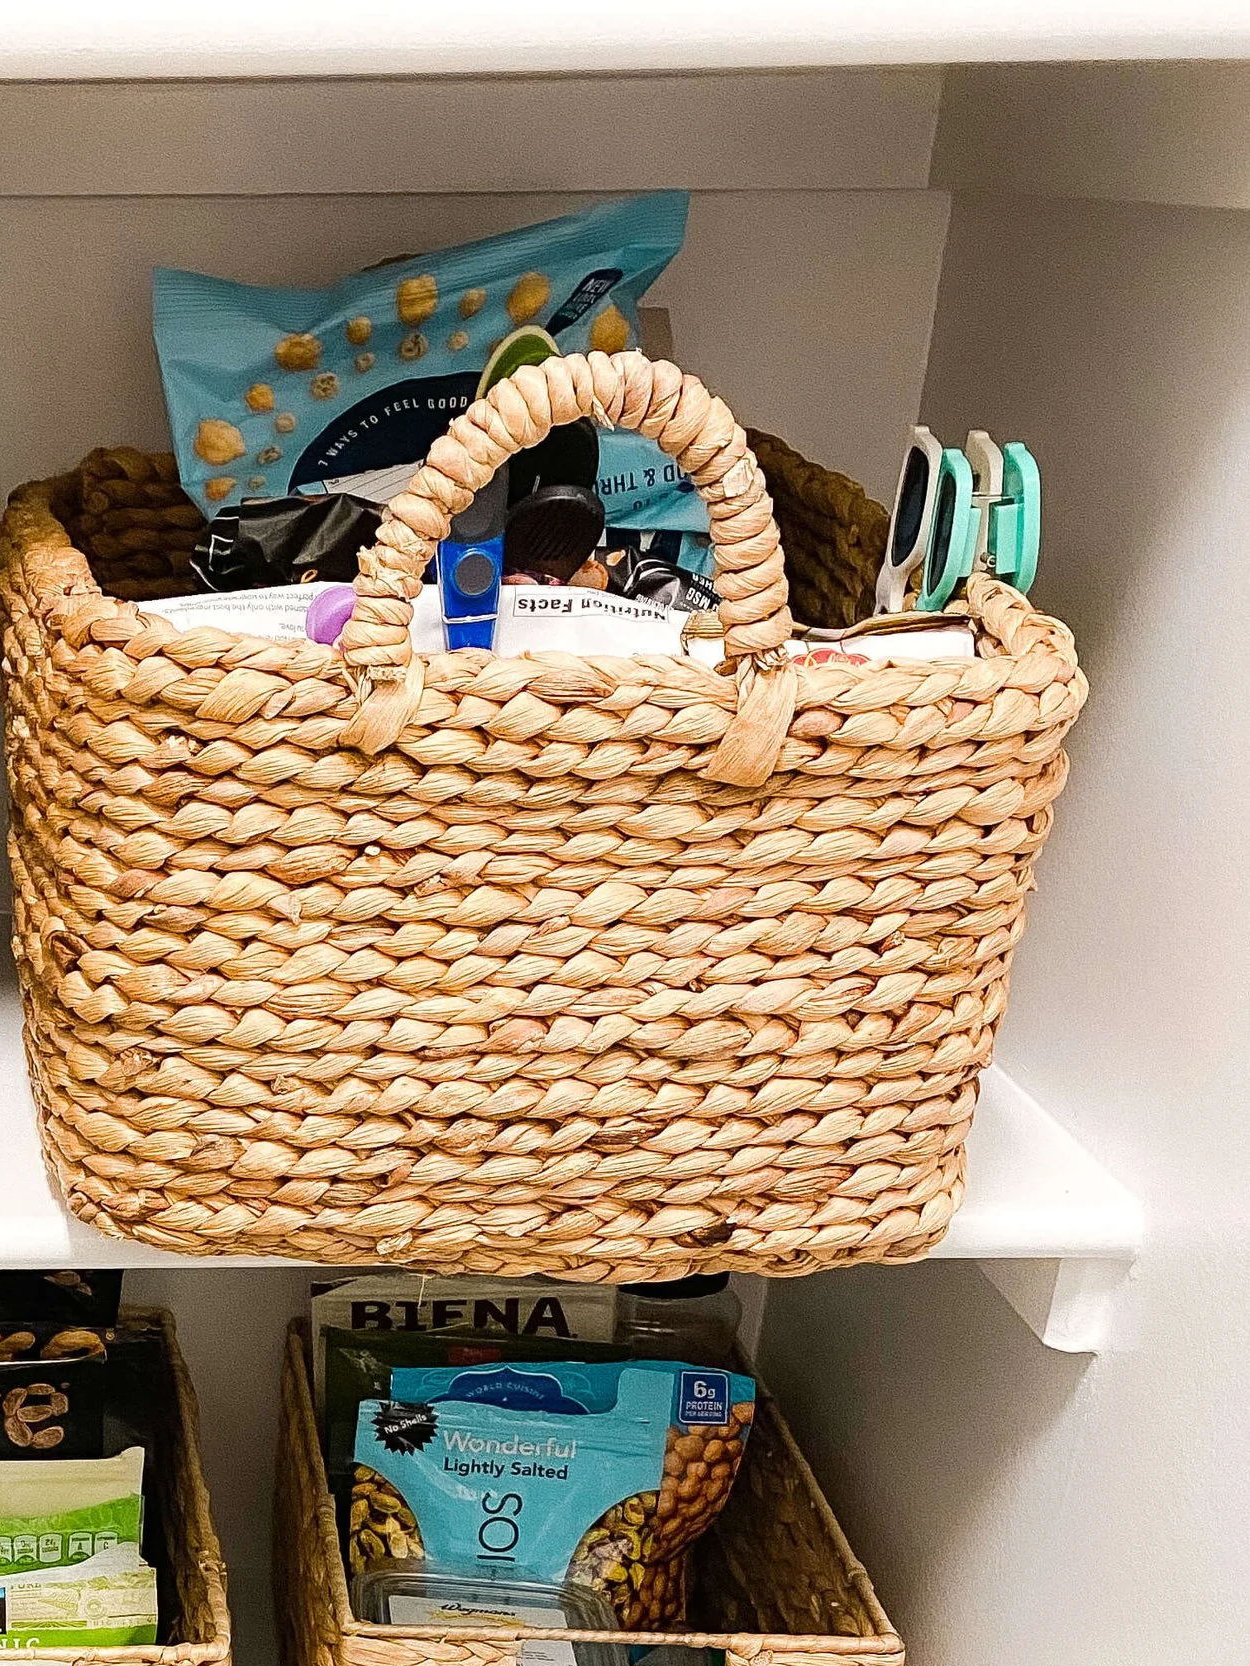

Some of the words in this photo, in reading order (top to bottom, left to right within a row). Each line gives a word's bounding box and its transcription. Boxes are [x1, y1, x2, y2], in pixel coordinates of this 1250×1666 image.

[325, 429, 358, 458] WAYS
[359, 414, 379, 430] TO
[383, 398, 420, 417] FEEL
[427, 396, 469, 410] GOOD
[517, 598, 573, 614] Facts
[581, 597, 666, 621] Nutrition
[693, 1380, 717, 1399] 6g
[685, 1400, 723, 1412] PROTEIN
[383, 1422, 399, 1434] No
[400, 1414, 428, 1430] Shells
[442, 1430, 577, 1459] Wonderful
[443, 1456, 506, 1478] Lightly
[510, 1461, 569, 1481] Salted
